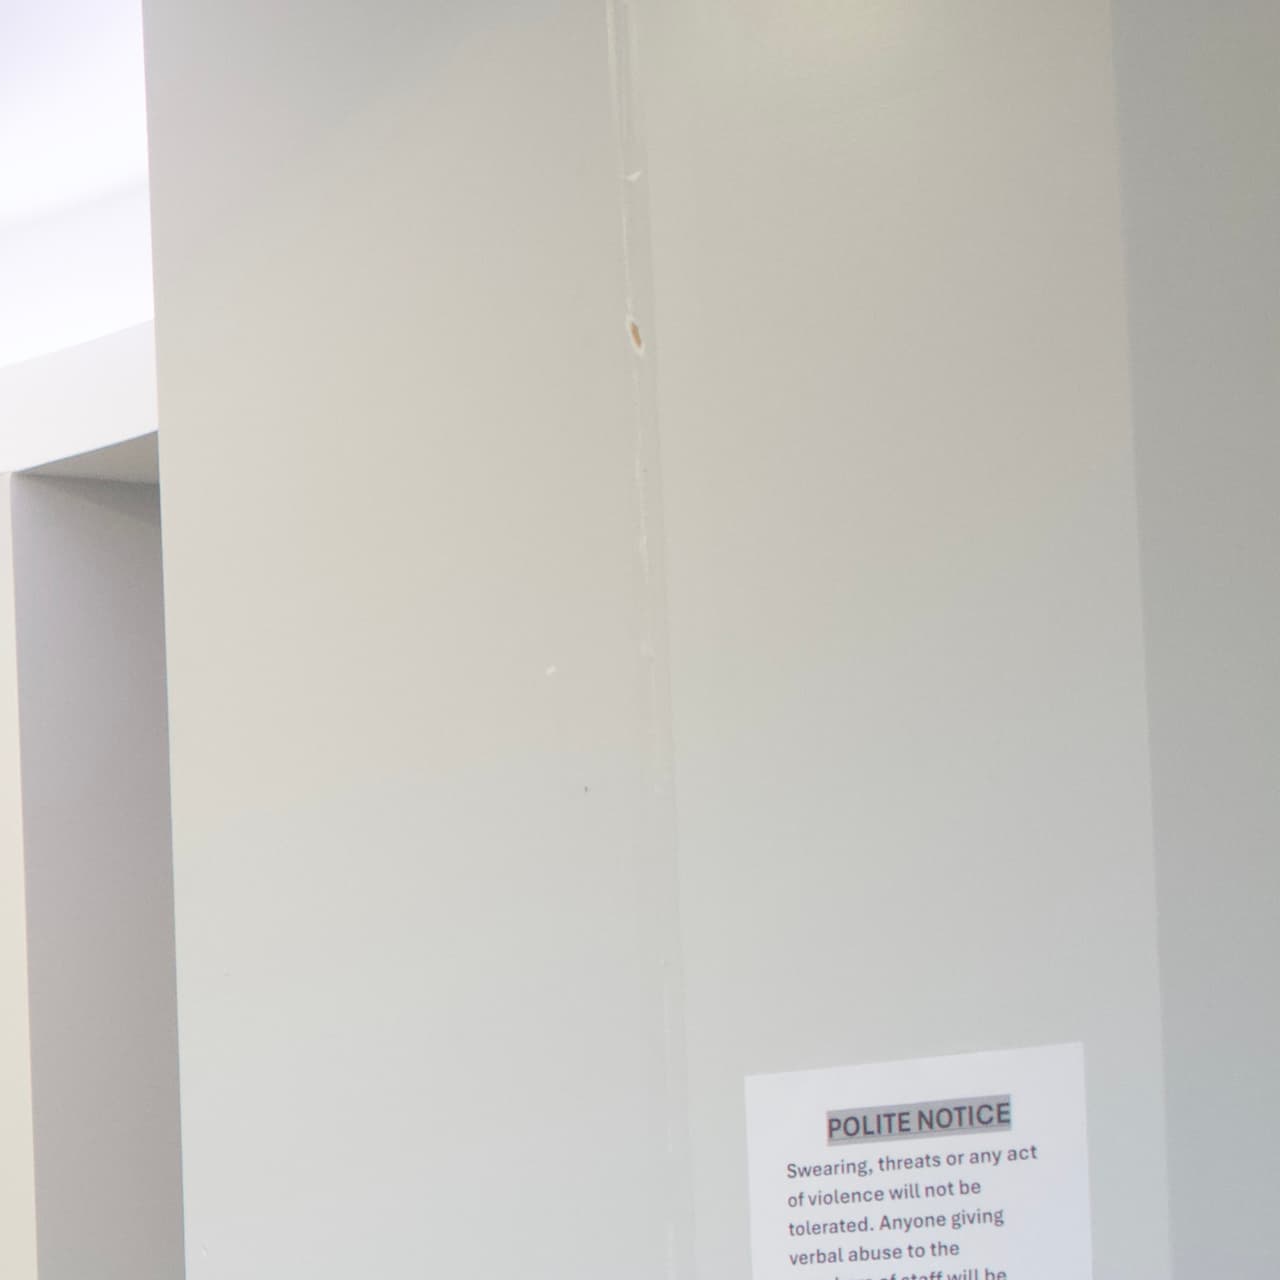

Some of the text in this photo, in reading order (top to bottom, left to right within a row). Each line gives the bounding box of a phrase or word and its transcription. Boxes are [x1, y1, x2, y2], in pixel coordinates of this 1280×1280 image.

[828, 1102, 1011, 1138] POLITE NOTICE
[787, 1145, 1037, 1178] Swearing, threats or any act
[788, 1179, 981, 1207] of violence will not be
[789, 1209, 1004, 1237] tolerated. Anyone giving
[790, 1241, 960, 1266] verbal abuse to the
